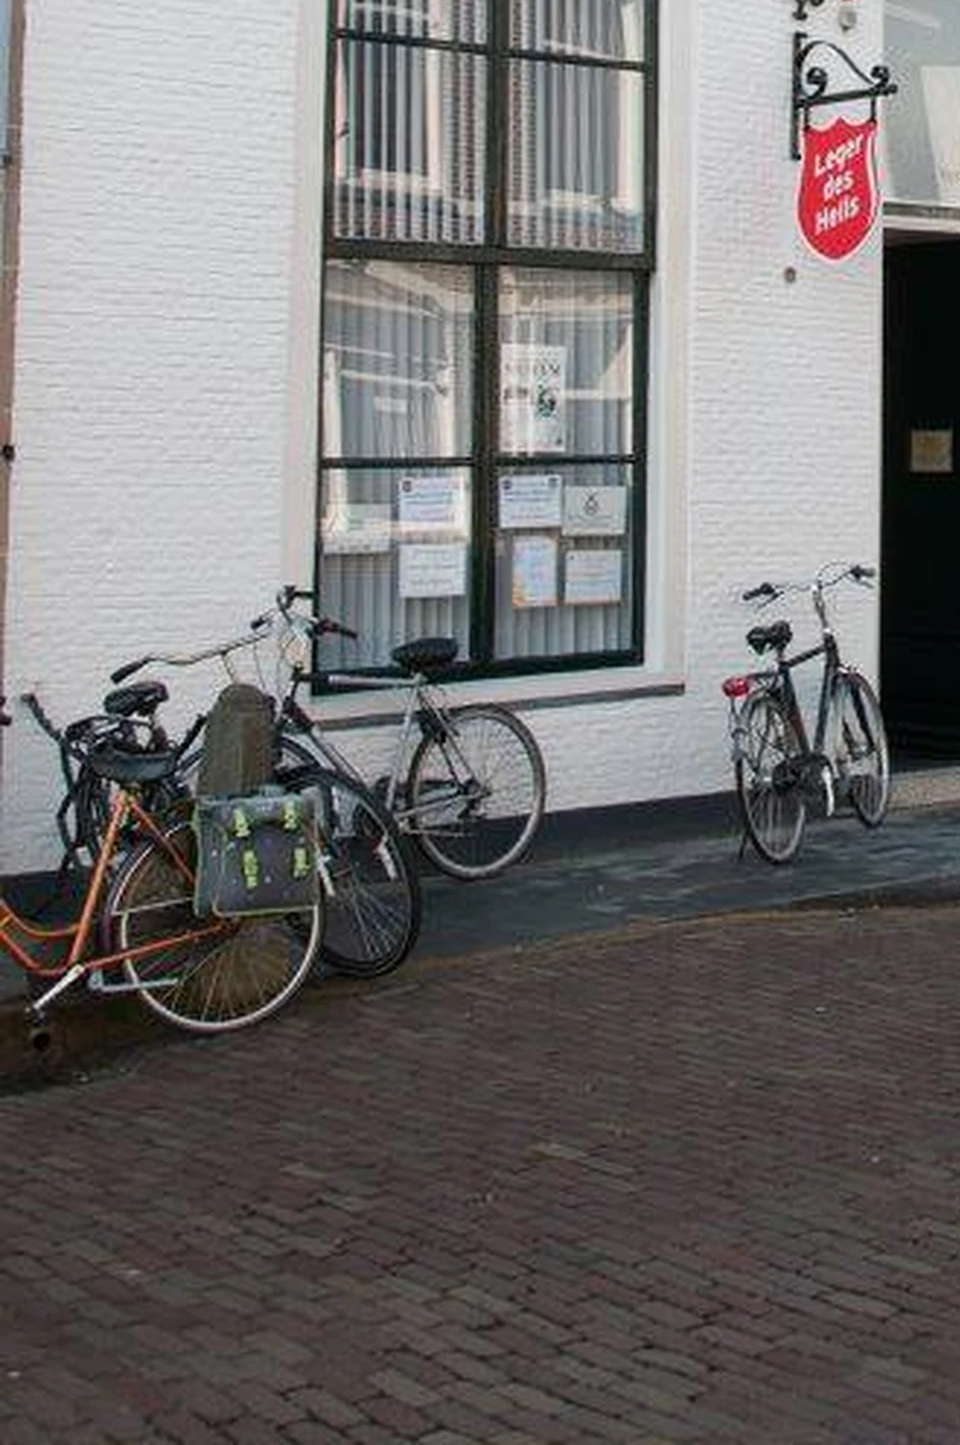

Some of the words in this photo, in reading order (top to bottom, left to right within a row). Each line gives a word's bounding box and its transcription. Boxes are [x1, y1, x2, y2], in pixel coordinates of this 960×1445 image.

[815, 135, 864, 176] Leger
[824, 172, 854, 201] des
[815, 196, 859, 234] Heils
